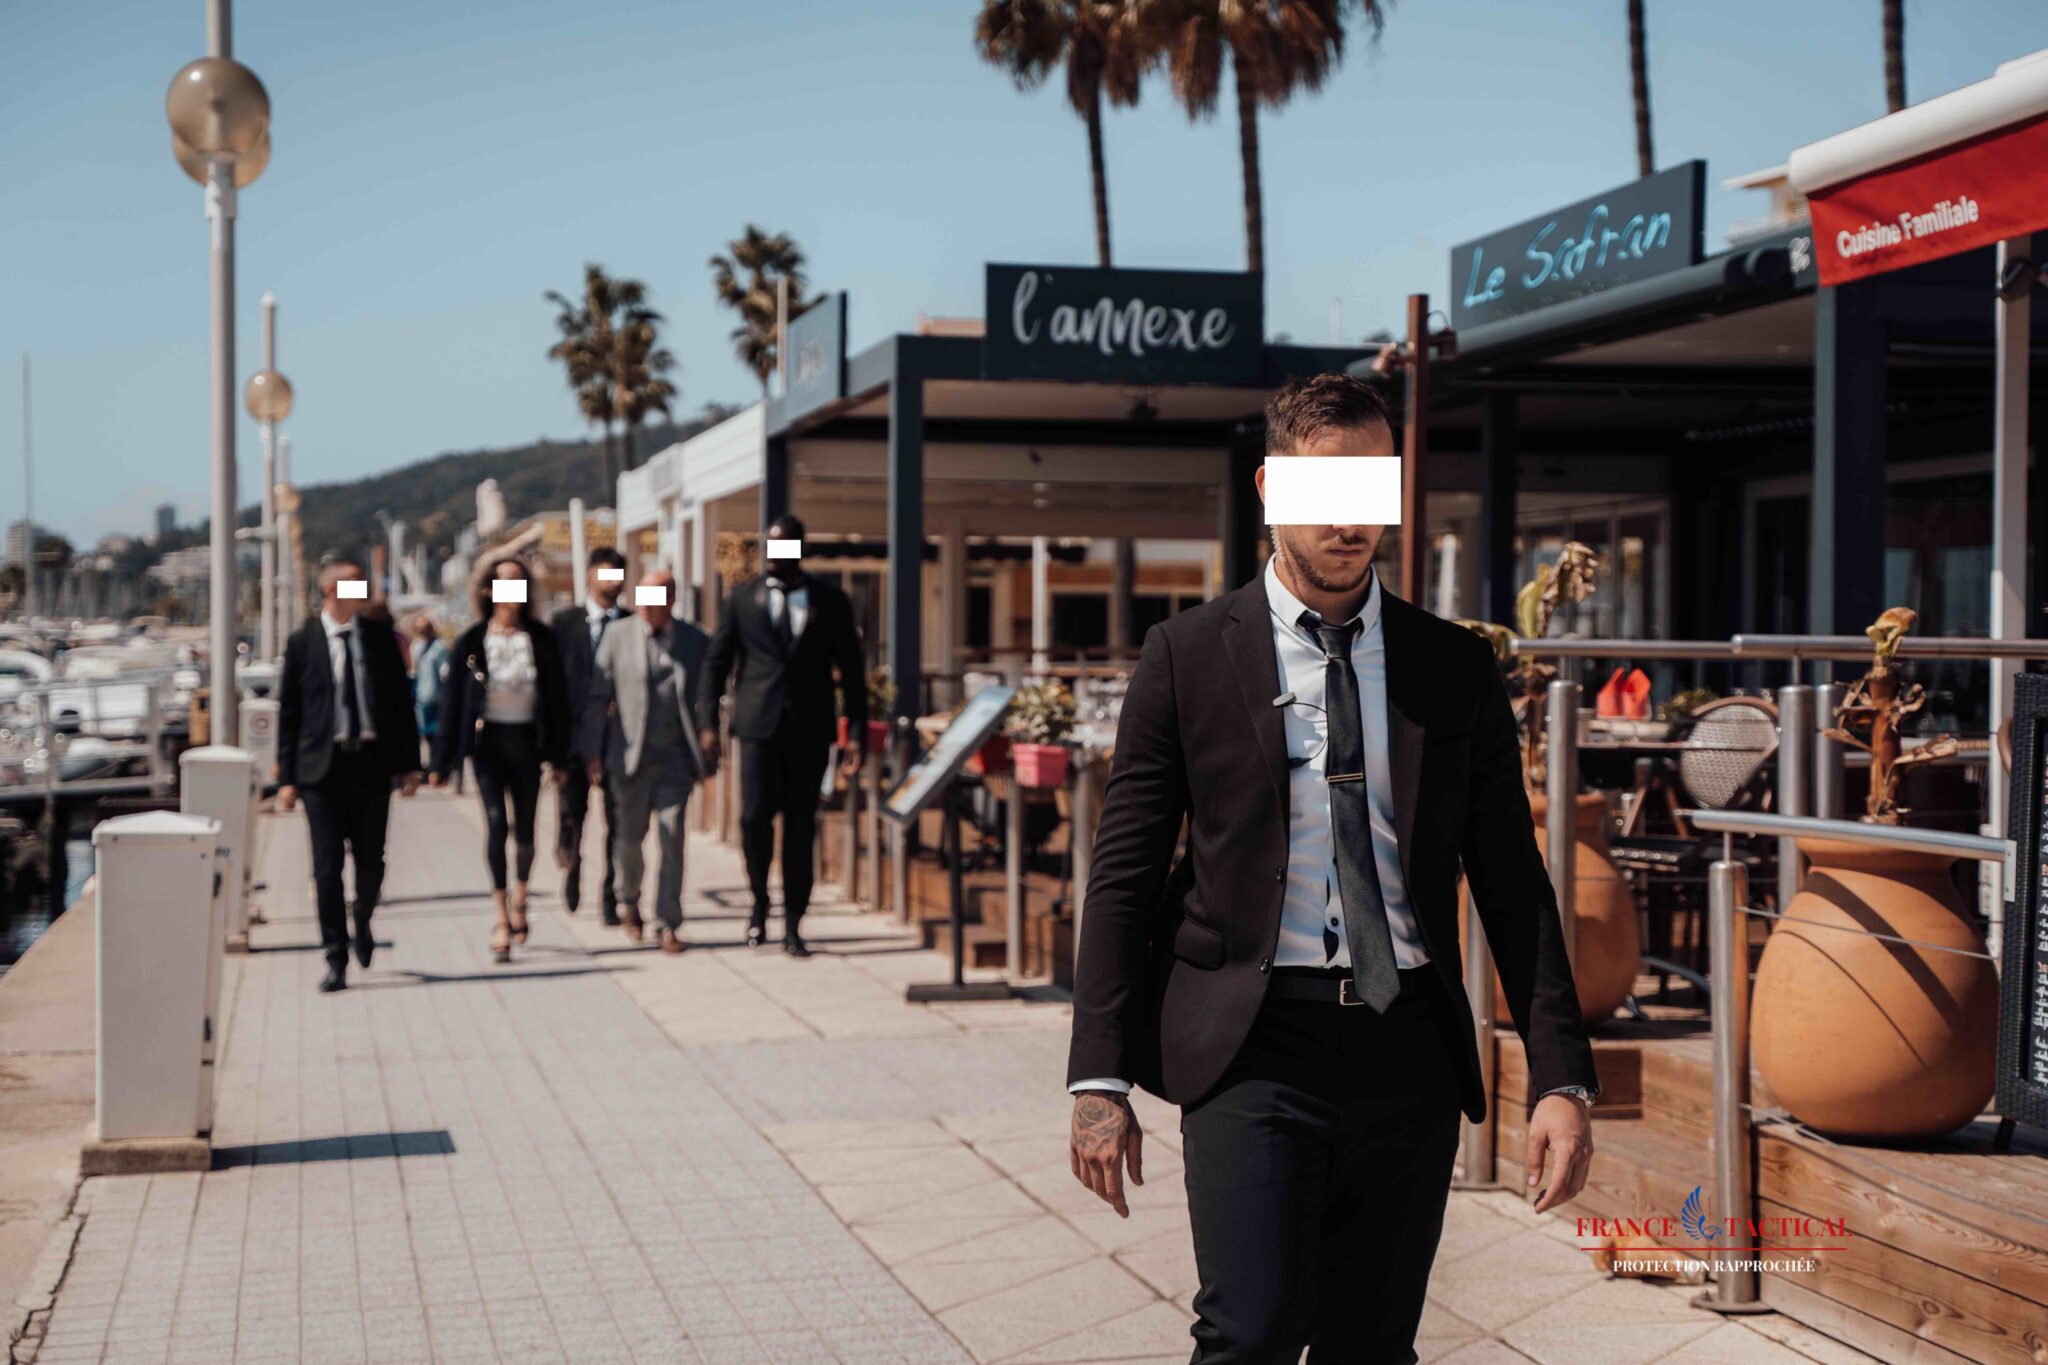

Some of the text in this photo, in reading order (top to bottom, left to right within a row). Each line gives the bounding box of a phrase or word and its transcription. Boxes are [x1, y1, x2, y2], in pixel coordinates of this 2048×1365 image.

[1462, 247, 1506, 309] Le
[1522, 204, 1671, 289] Safran
[1836, 195, 1979, 258] Cuisine Familiale
